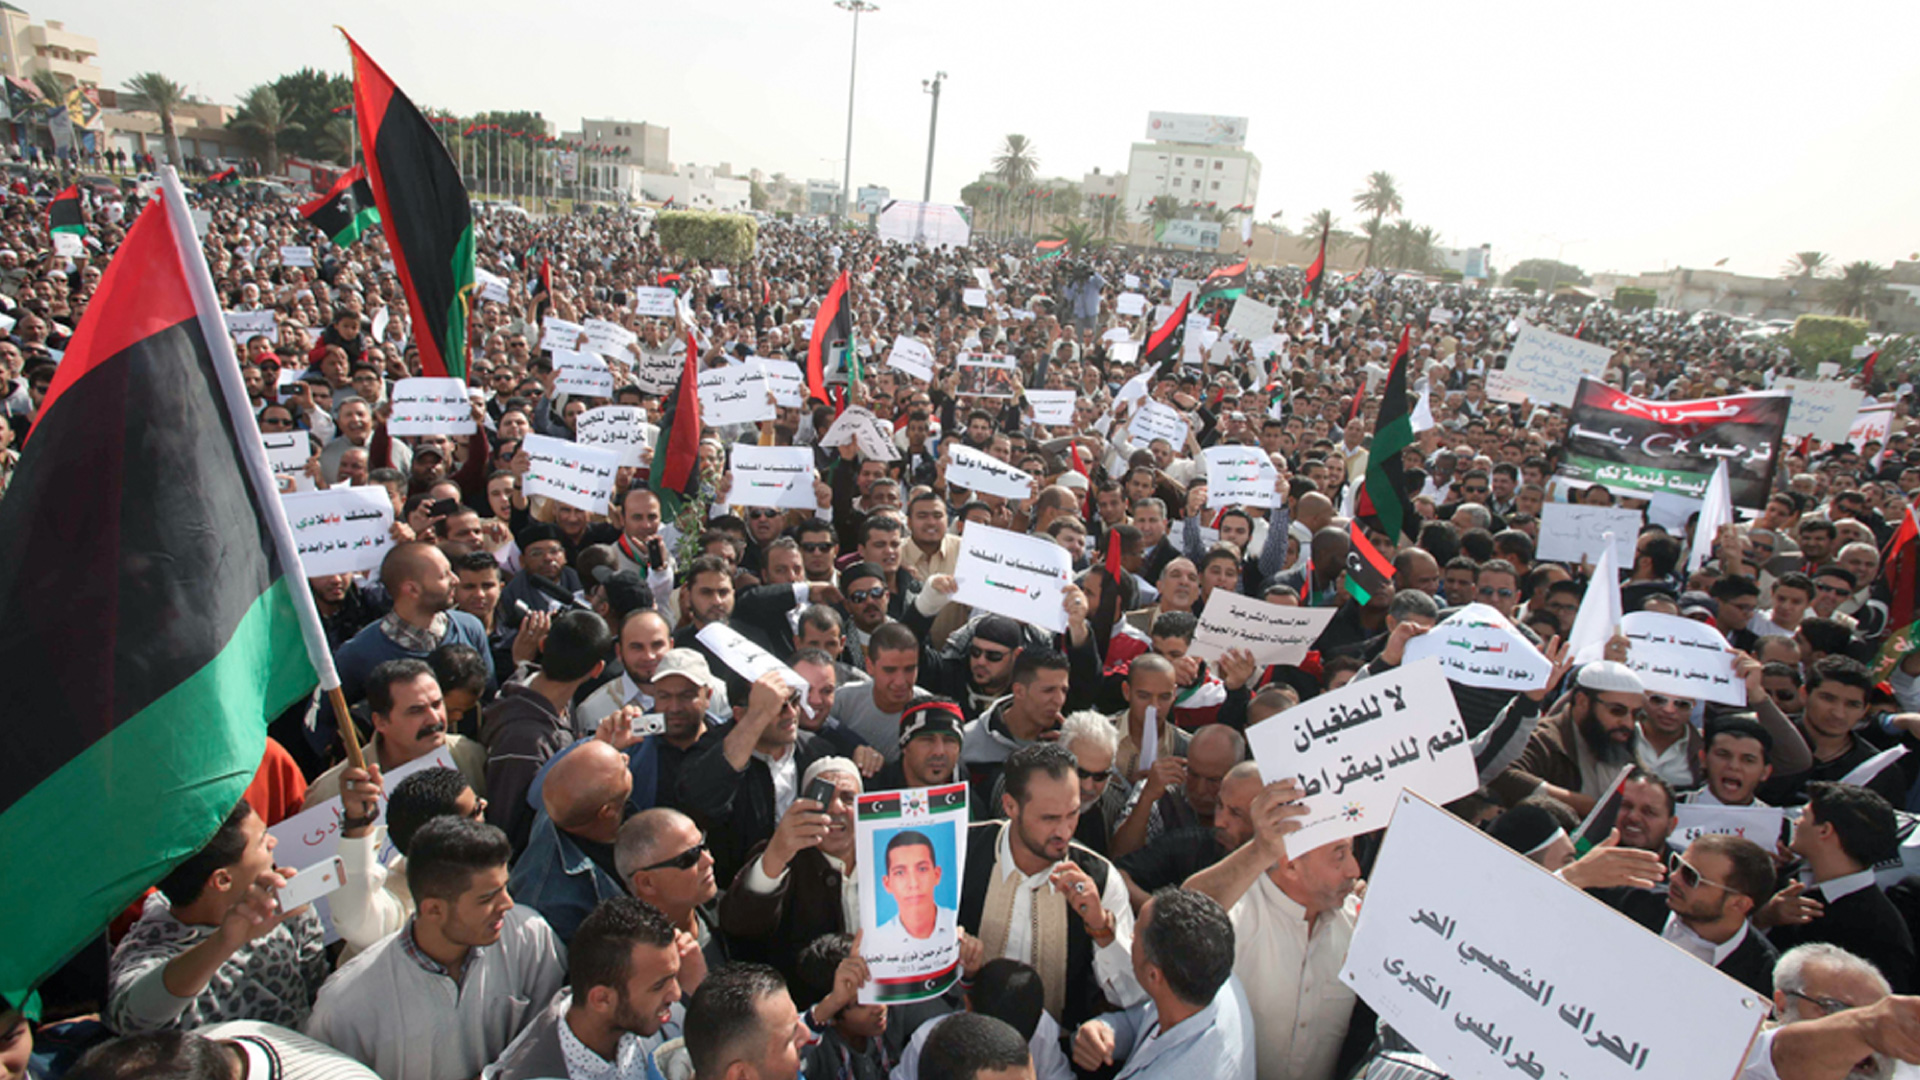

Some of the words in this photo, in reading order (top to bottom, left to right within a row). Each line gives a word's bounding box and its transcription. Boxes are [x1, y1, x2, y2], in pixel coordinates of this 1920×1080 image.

[1700, 441, 1772, 463] ترحب
[1595, 464, 1621, 480] لكم
[1622, 466, 1665, 488] غنيمة
[969, 546, 1004, 564] المسلحة
[984, 574, 1030, 594] ليبيا
[1029, 588, 1042, 600] في
[1229, 604, 1269, 622] الشرعية
[1446, 637, 1509, 654] الشرطة
[1468, 662, 1505, 676] الخدمة
[1384, 684, 1407, 712] لا
[1294, 694, 1383, 753] للطغيان
[1427, 719, 1466, 762] نعم
[1278, 736, 1421, 807] للديمقراط
[1410, 909, 1457, 940] الحر
[1383, 957, 1451, 1010] الكبرى
[1457, 941, 1555, 1007] الشعبي
[1454, 1012, 1545, 1080] طرابلس
[1558, 1003, 1650, 1071] الحراك
